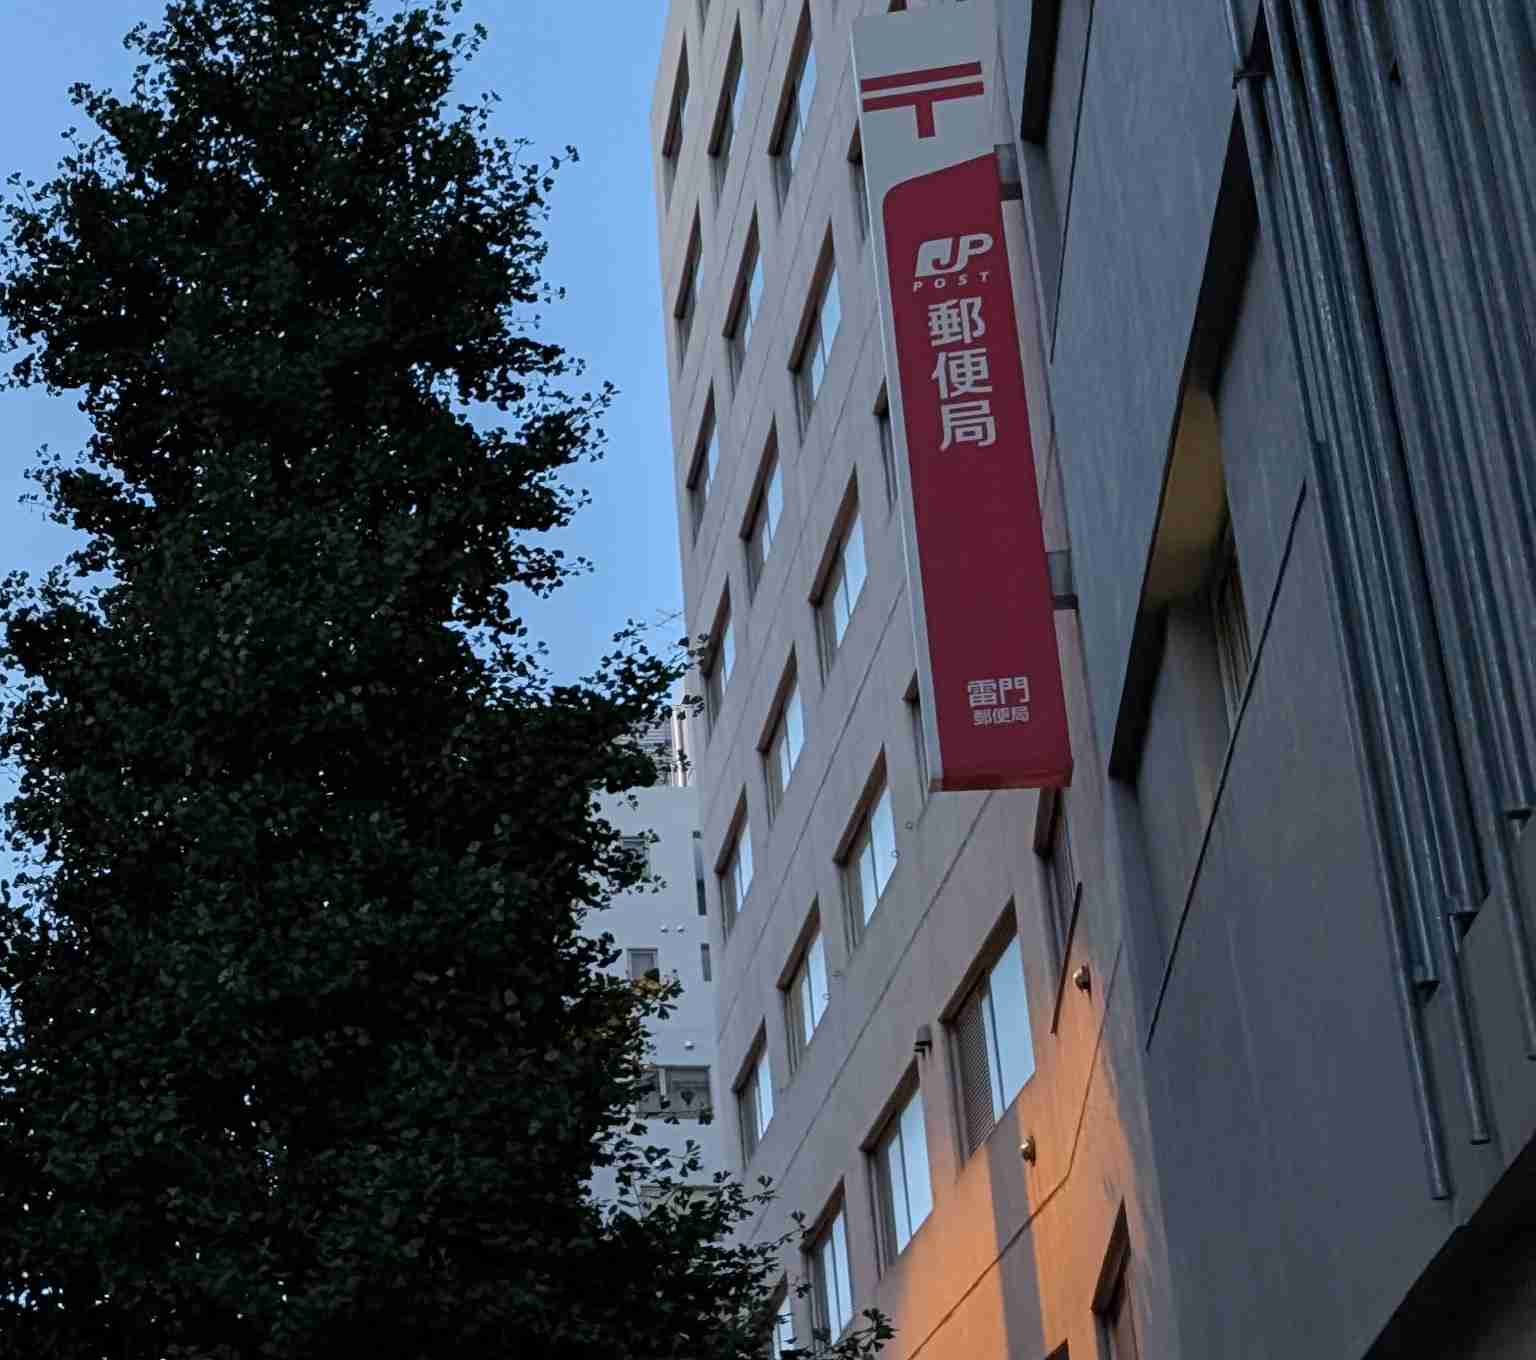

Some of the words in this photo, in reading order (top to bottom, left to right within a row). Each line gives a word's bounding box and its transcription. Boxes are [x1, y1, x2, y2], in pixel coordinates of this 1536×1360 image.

[912, 270, 991, 293] POST
[927, 295, 997, 452] 郵便局
[967, 675, 1031, 708] 雷門
[972, 706, 1030, 727] 郵便局
